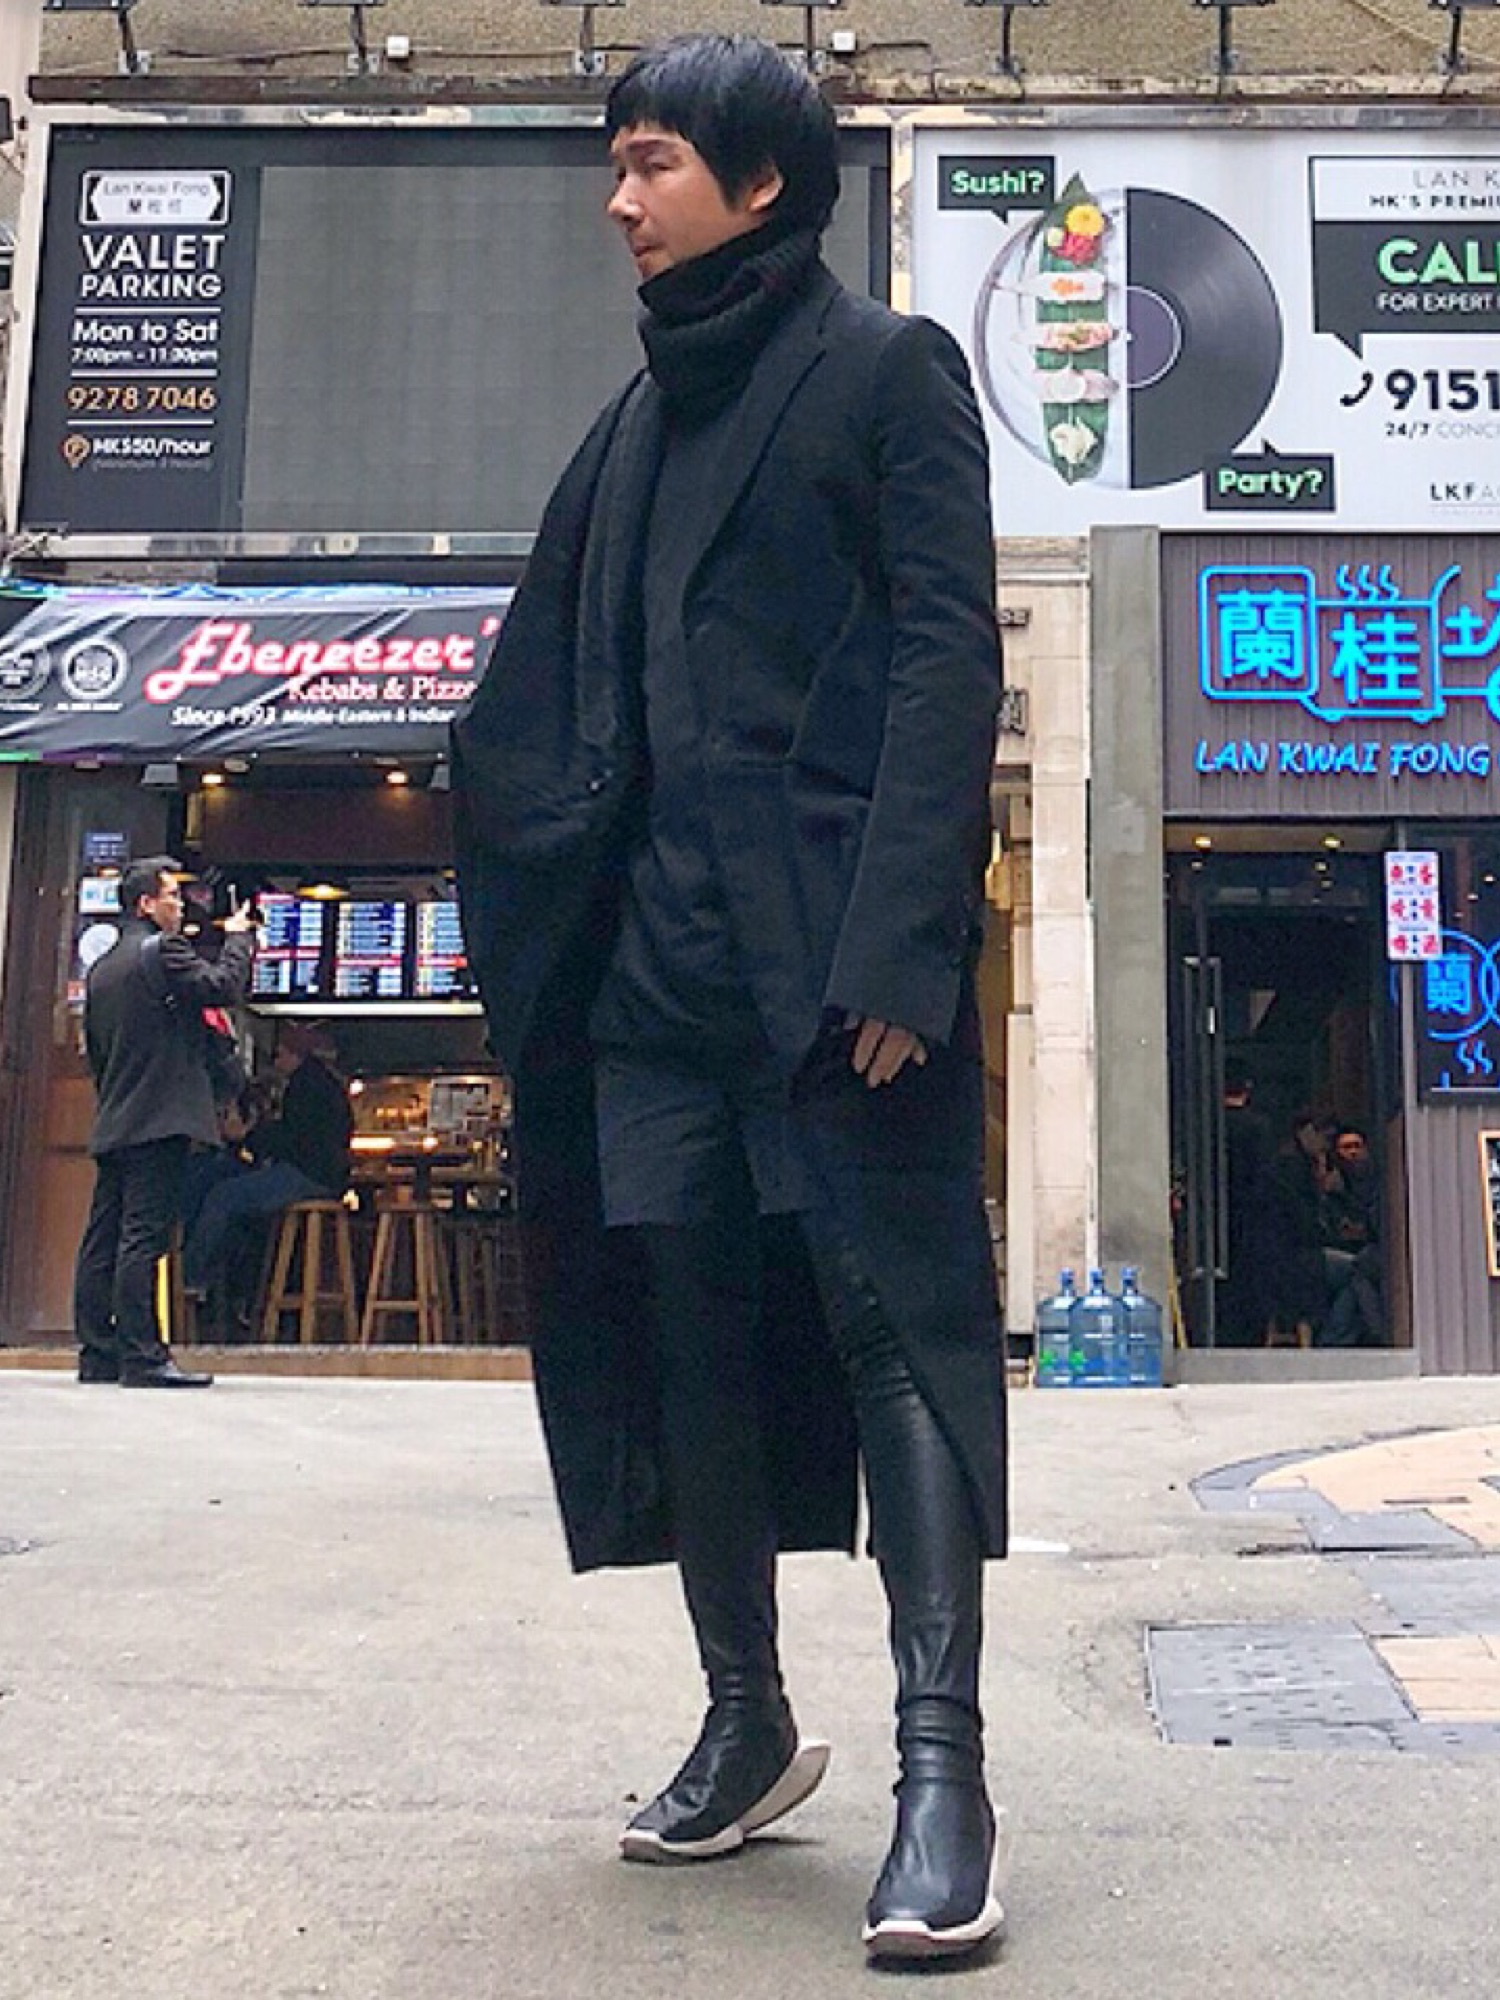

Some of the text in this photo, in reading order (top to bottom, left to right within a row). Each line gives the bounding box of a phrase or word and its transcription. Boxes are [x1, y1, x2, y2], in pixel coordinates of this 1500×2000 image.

[950, 168, 1045, 194] Sushi?
[1412, 170, 1469, 189] LAN
[1368, 194, 1421, 207] HK'S
[81, 234, 226, 270] VALET
[81, 274, 223, 298] PARKING
[1377, 292, 1418, 312] FOR
[1423, 292, 1494, 312] EXPERT
[72, 318, 218, 342] Mon to Sat
[67, 386, 217, 411] 9278 7046
[1385, 369, 1500, 411] 9151
[1385, 422, 1430, 439] 24/7
[1218, 467, 1325, 501] Party?
[288, 675, 378, 701] Kebabs
[383, 676, 407, 701] &
[170, 705, 226, 726] Since
[1195, 741, 1270, 774] LAN
[1277, 741, 1381, 774] KWAI
[1389, 743, 1491, 777] FONG
